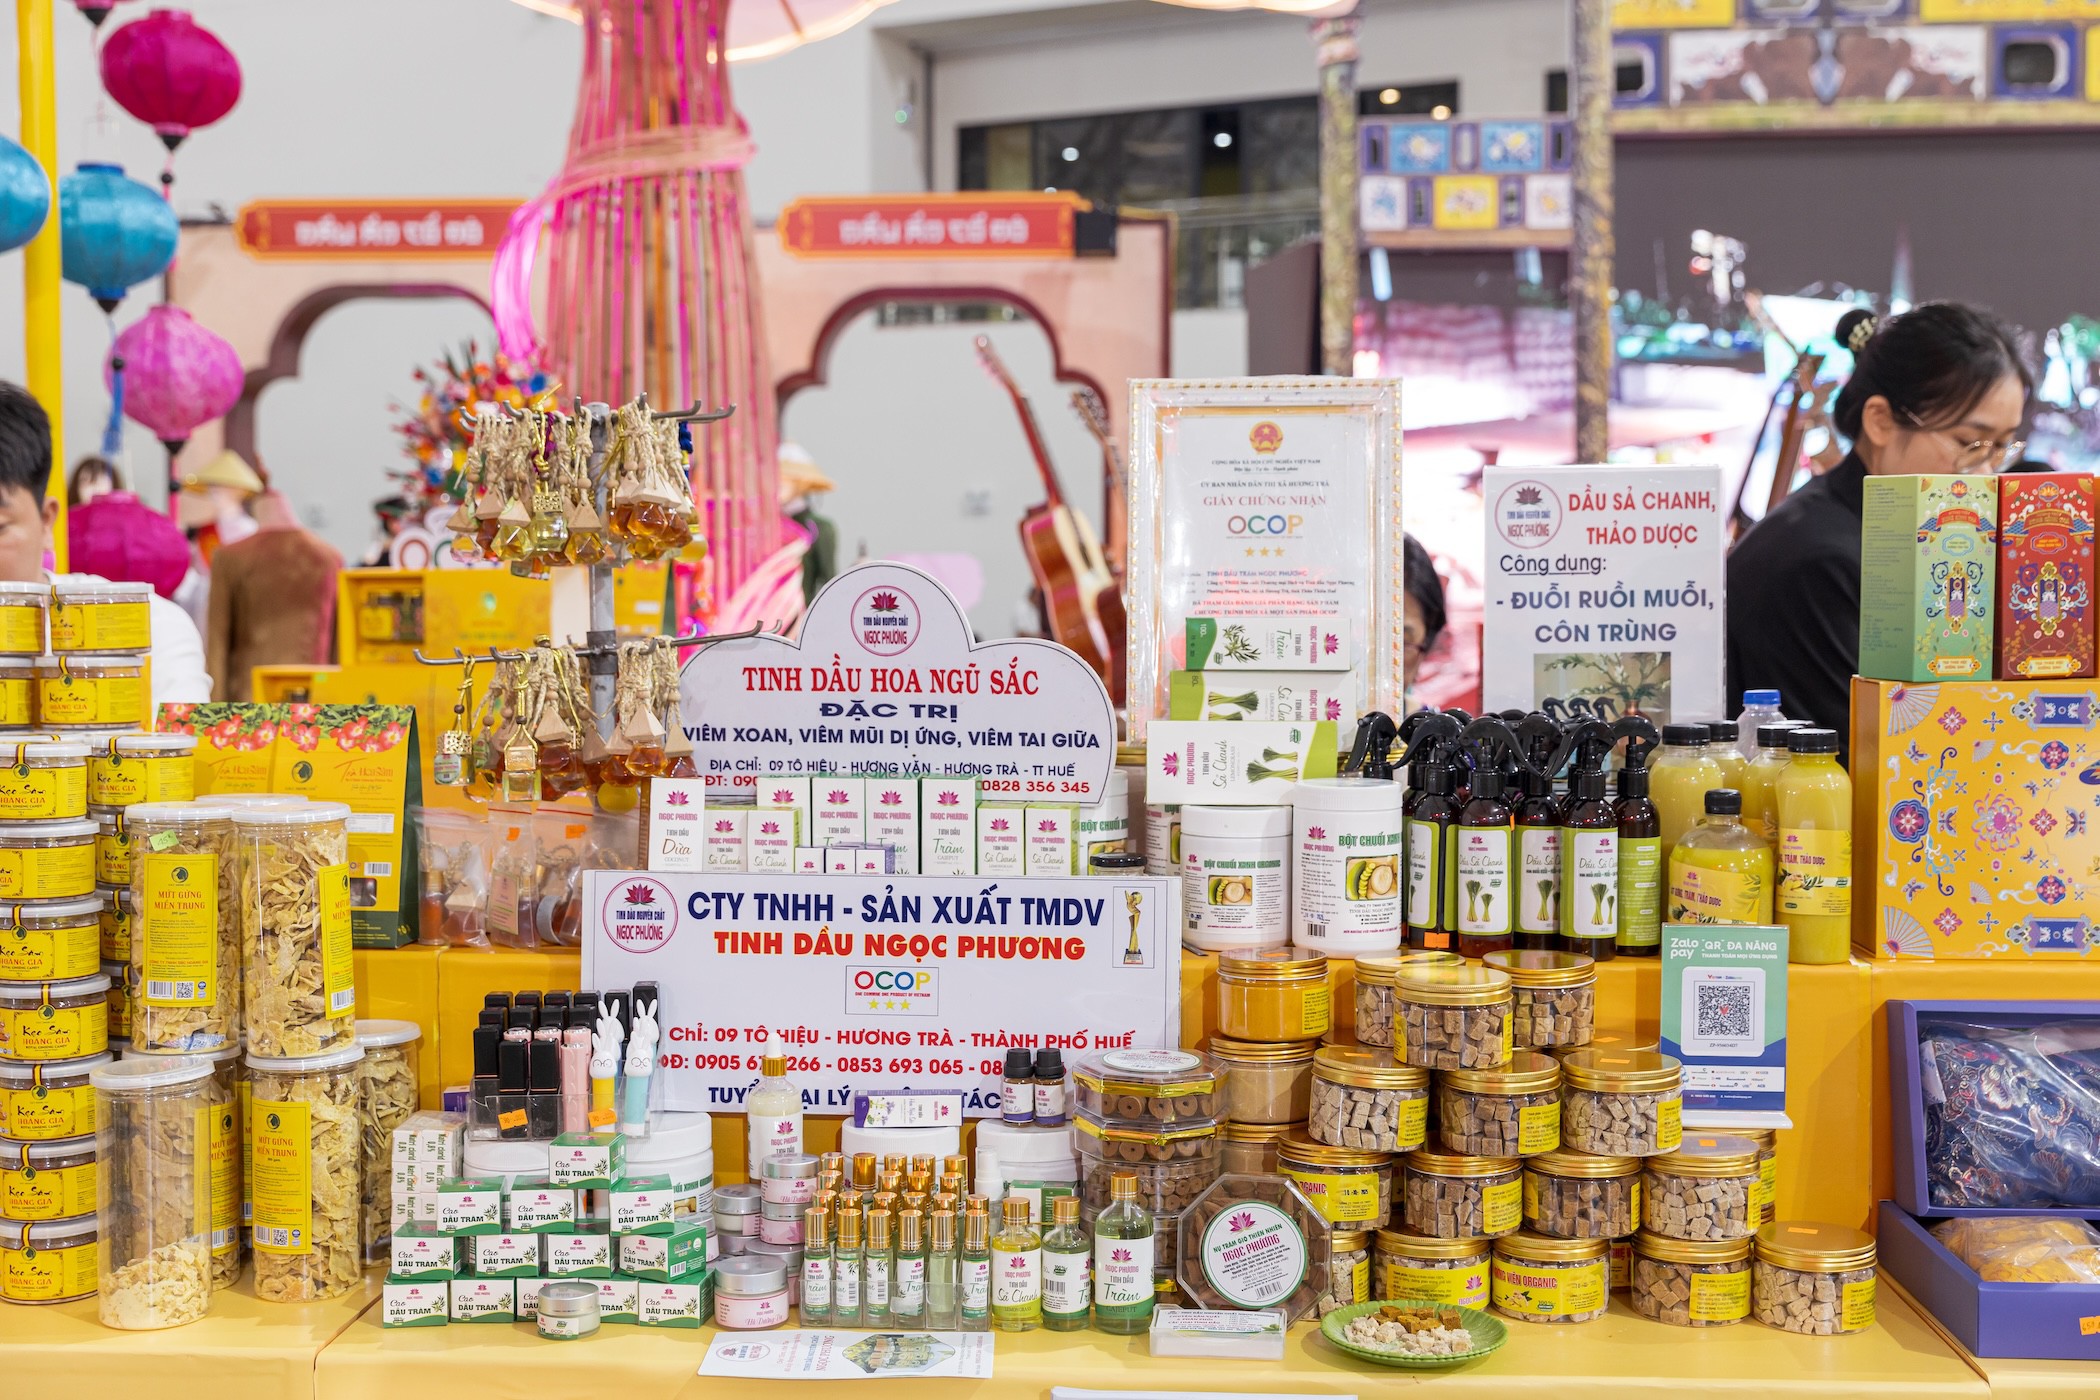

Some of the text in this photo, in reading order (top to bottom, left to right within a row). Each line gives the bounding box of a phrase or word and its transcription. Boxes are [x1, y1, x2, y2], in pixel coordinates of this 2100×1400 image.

[1569, 484, 1716, 512] DẦU SẢ CHANH,
[1228, 514, 1303, 534] OCOP
[1586, 521, 1698, 549] THẢO DƯỢC
[1500, 554, 1606, 576] Công dụng:
[1511, 580, 1714, 610] ĐUỖI RUỒI MUỖI,
[864, 630, 880, 648] NGỌC
[1535, 619, 1677, 642] CÔN TRÙNG
[1276, 628, 1292, 660] Tràm
[742, 654, 1039, 695] TINH DẦU HOA NGŨ SẮC
[819, 700, 958, 722] ĐẶC TRỊ
[683, 724, 1100, 748] VIÊM XOAN, VIÊM MŨI DỊ ỨNG, VIÊM TAI GIỮA
[1214, 740, 1228, 769] Chanh
[710, 760, 732, 773] ĐỊA
[736, 756, 762, 771] CHỈ:
[769, 760, 784, 771] 09
[787, 758, 802, 771] TÔ
[850, 760, 898, 773] HƯƠNG
[944, 764, 992, 775] HƯƠNG
[996, 762, 1018, 776] TRÀ
[1032, 765, 1044, 776] TT
[1048, 762, 1076, 776] HUẾ
[982, 780, 1020, 792] 0828
[1026, 782, 1055, 792] 356
[1060, 782, 1090, 793] 345
[658, 812, 674, 821] NGỌC
[662, 838, 692, 855] Dừa
[933, 837, 965, 854] Tràm
[1339, 831, 1385, 849] BỘT CHUỐI
[616, 910, 625, 920] TINH
[688, 884, 1104, 926] CTY TNHH SẢN XUẤT TMDV
[616, 923, 663, 943] NGỌC PHƯƠNG
[1670, 938, 1699, 948] Zalo
[714, 926, 1086, 963] TINH DẦU NGỌC PHƯƠNG
[1670, 948, 1694, 959] pay
[1705, 940, 1777, 951] QR ĐA NĂNG
[854, 971, 931, 990] OCOP
[55, 1036, 70, 1044] GIA
[669, 1022, 1136, 1050] Chỉ: 09 TÔ HIỆU HƯƠNG TRÀ THÀNH PHỐ HUẾ
[695, 1054, 740, 1070] 0905
[787, 1056, 821, 1072] 266
[837, 1057, 882, 1073] 0853
[889, 1058, 921, 1074] 693
[930, 1059, 963, 1075] 065
[828, 1085, 851, 1106] LÝ
[555, 1160, 570, 1168] Cao
[1222, 1234, 1280, 1262] NGỌC PHƯƠNG
[1105, 1264, 1117, 1273] NGỌC
[1507, 1271, 1558, 1288] VIÊN ORGANIC
[1011, 1289, 1038, 1303] Chanh
[1104, 1283, 1141, 1300] Tràm
